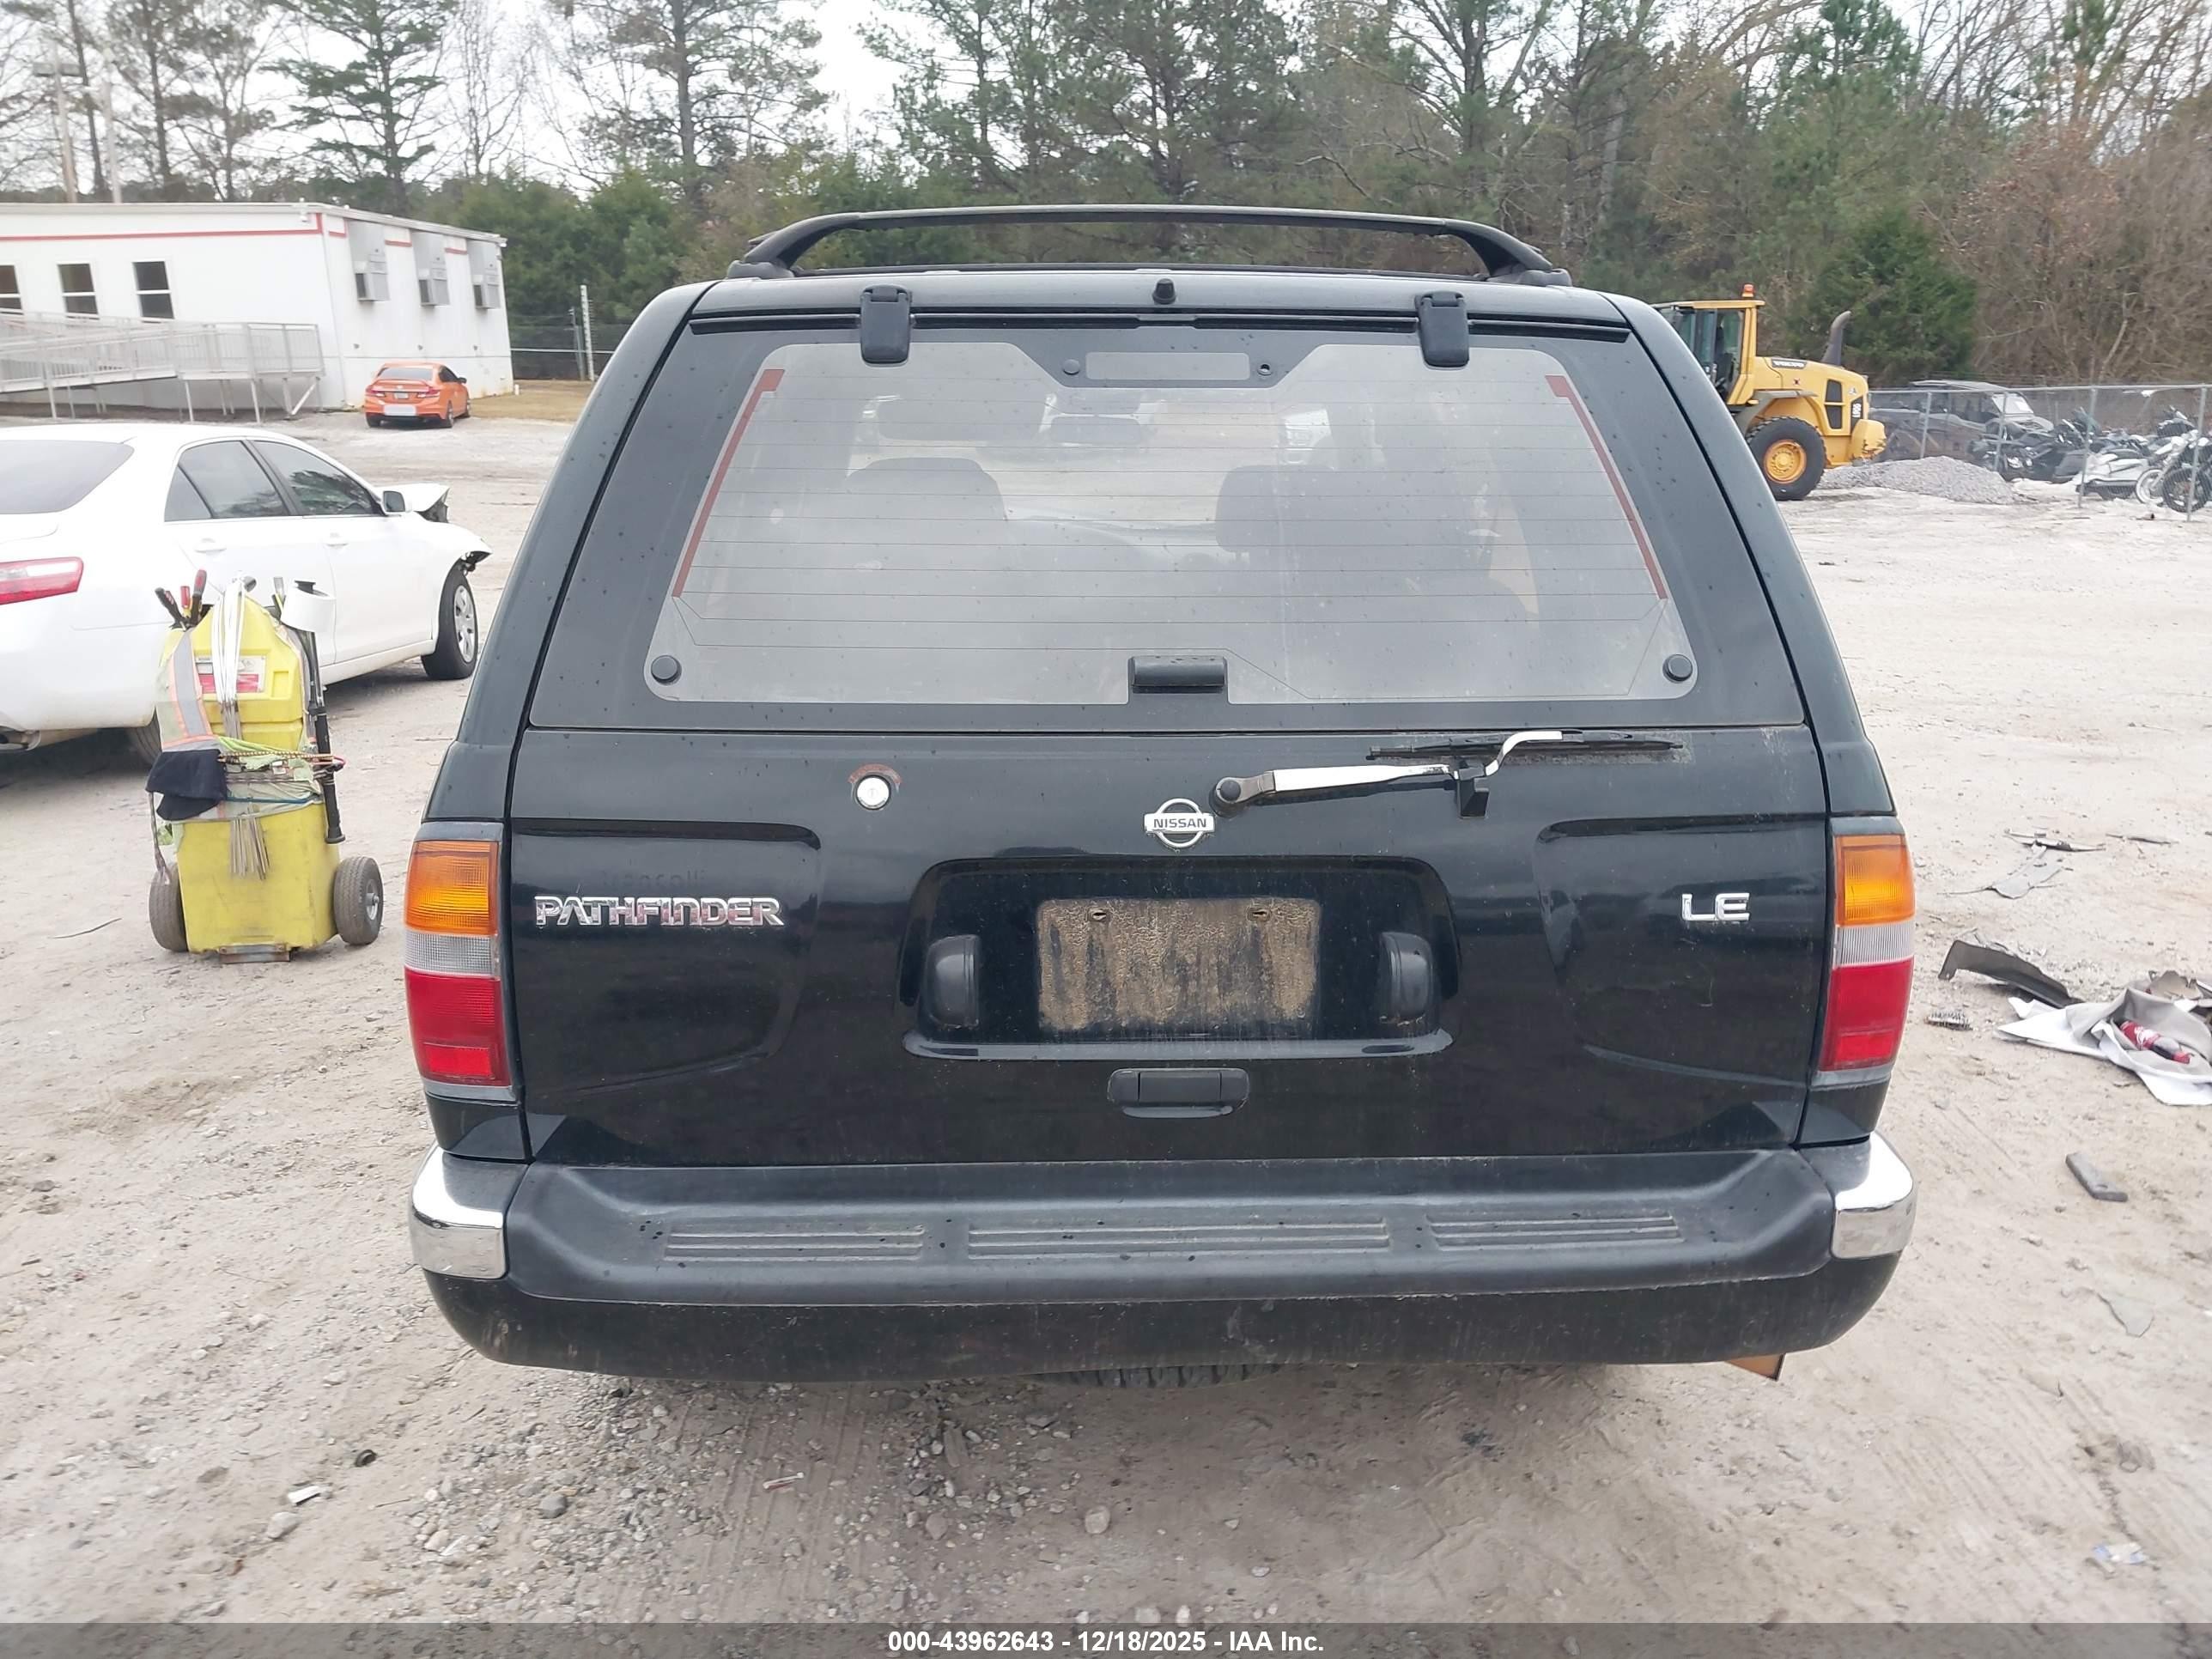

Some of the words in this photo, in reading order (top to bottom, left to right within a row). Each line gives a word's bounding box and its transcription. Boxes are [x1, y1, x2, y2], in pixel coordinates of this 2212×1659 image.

[1153, 818, 1206, 829] NISSAN
[534, 896, 785, 927] PATHFINDER
[1681, 892, 1750, 921] LE
